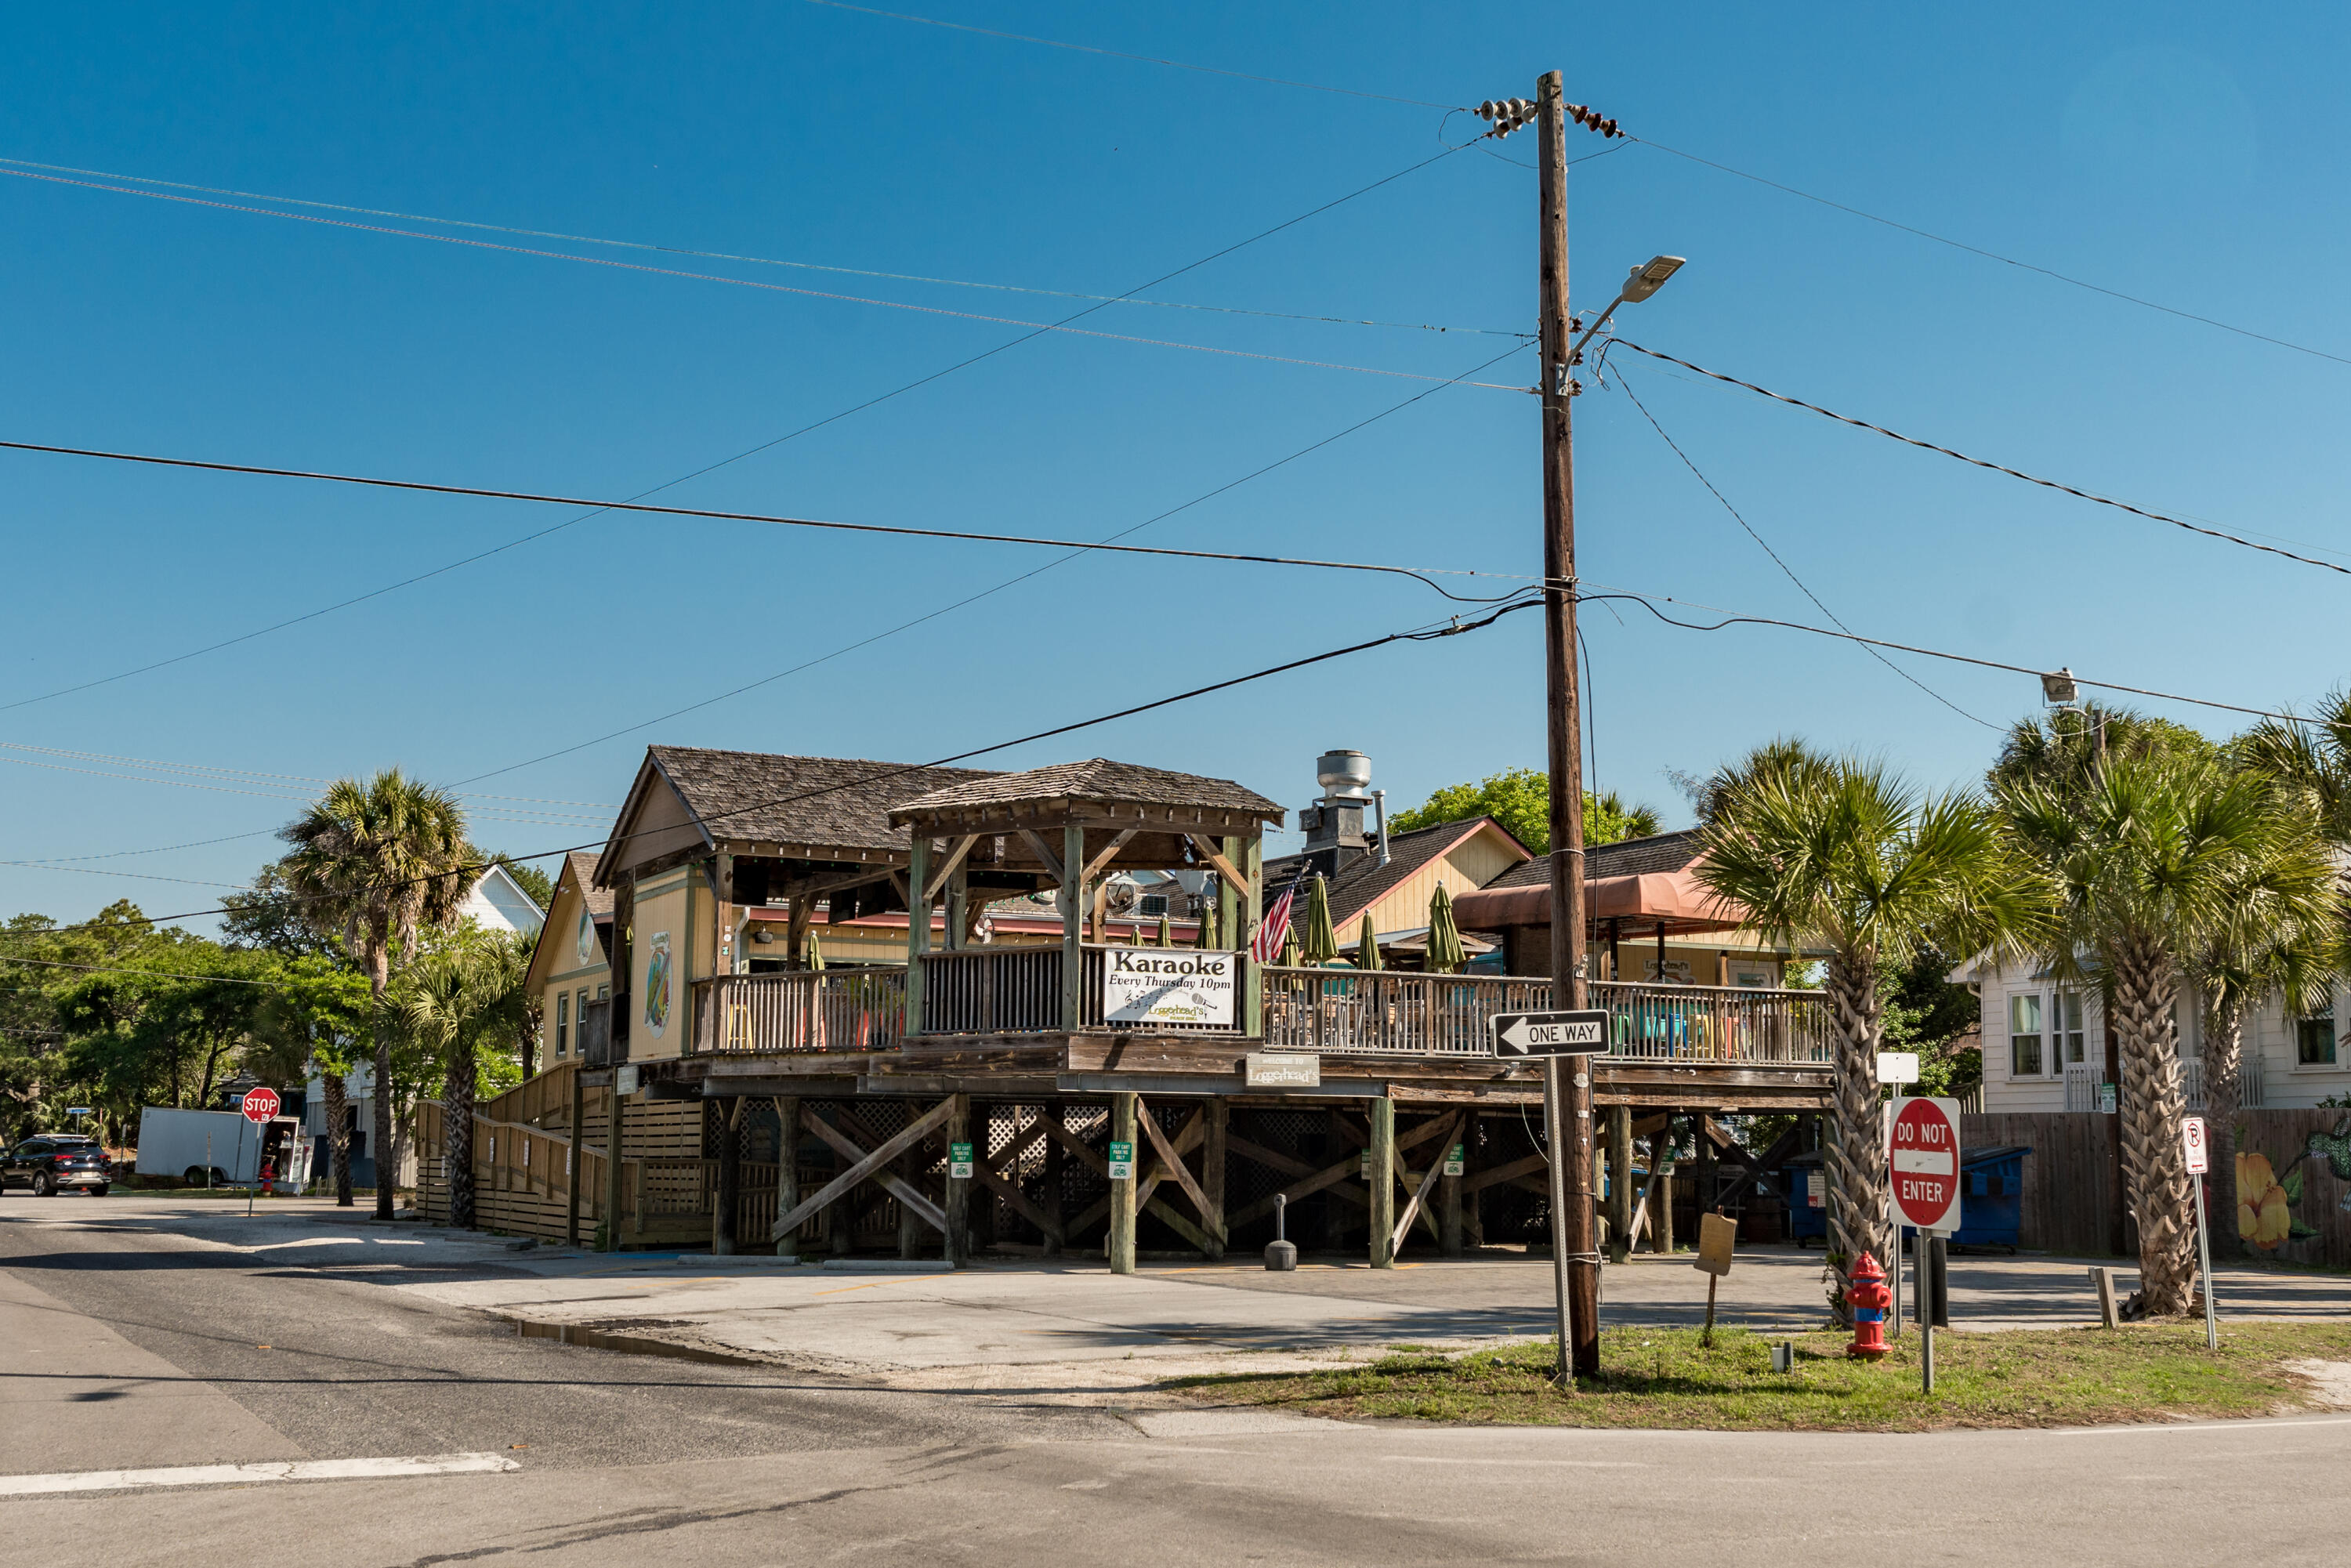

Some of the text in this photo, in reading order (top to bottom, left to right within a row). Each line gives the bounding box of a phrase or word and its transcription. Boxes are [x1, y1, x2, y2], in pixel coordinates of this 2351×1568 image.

[1114, 951, 1225, 976] Karaoke
[1109, 975, 1230, 990] Every Thursday 10pm
[1148, 1004, 1204, 1016] Loggerhead's
[1530, 1024, 1596, 1043] ONE WAY
[1248, 1067, 1318, 1084] Loggerhead's
[245, 1098, 277, 1112] STOP
[1898, 1122, 1947, 1143] DO NOT
[1903, 1179, 1943, 1203] ENTER
